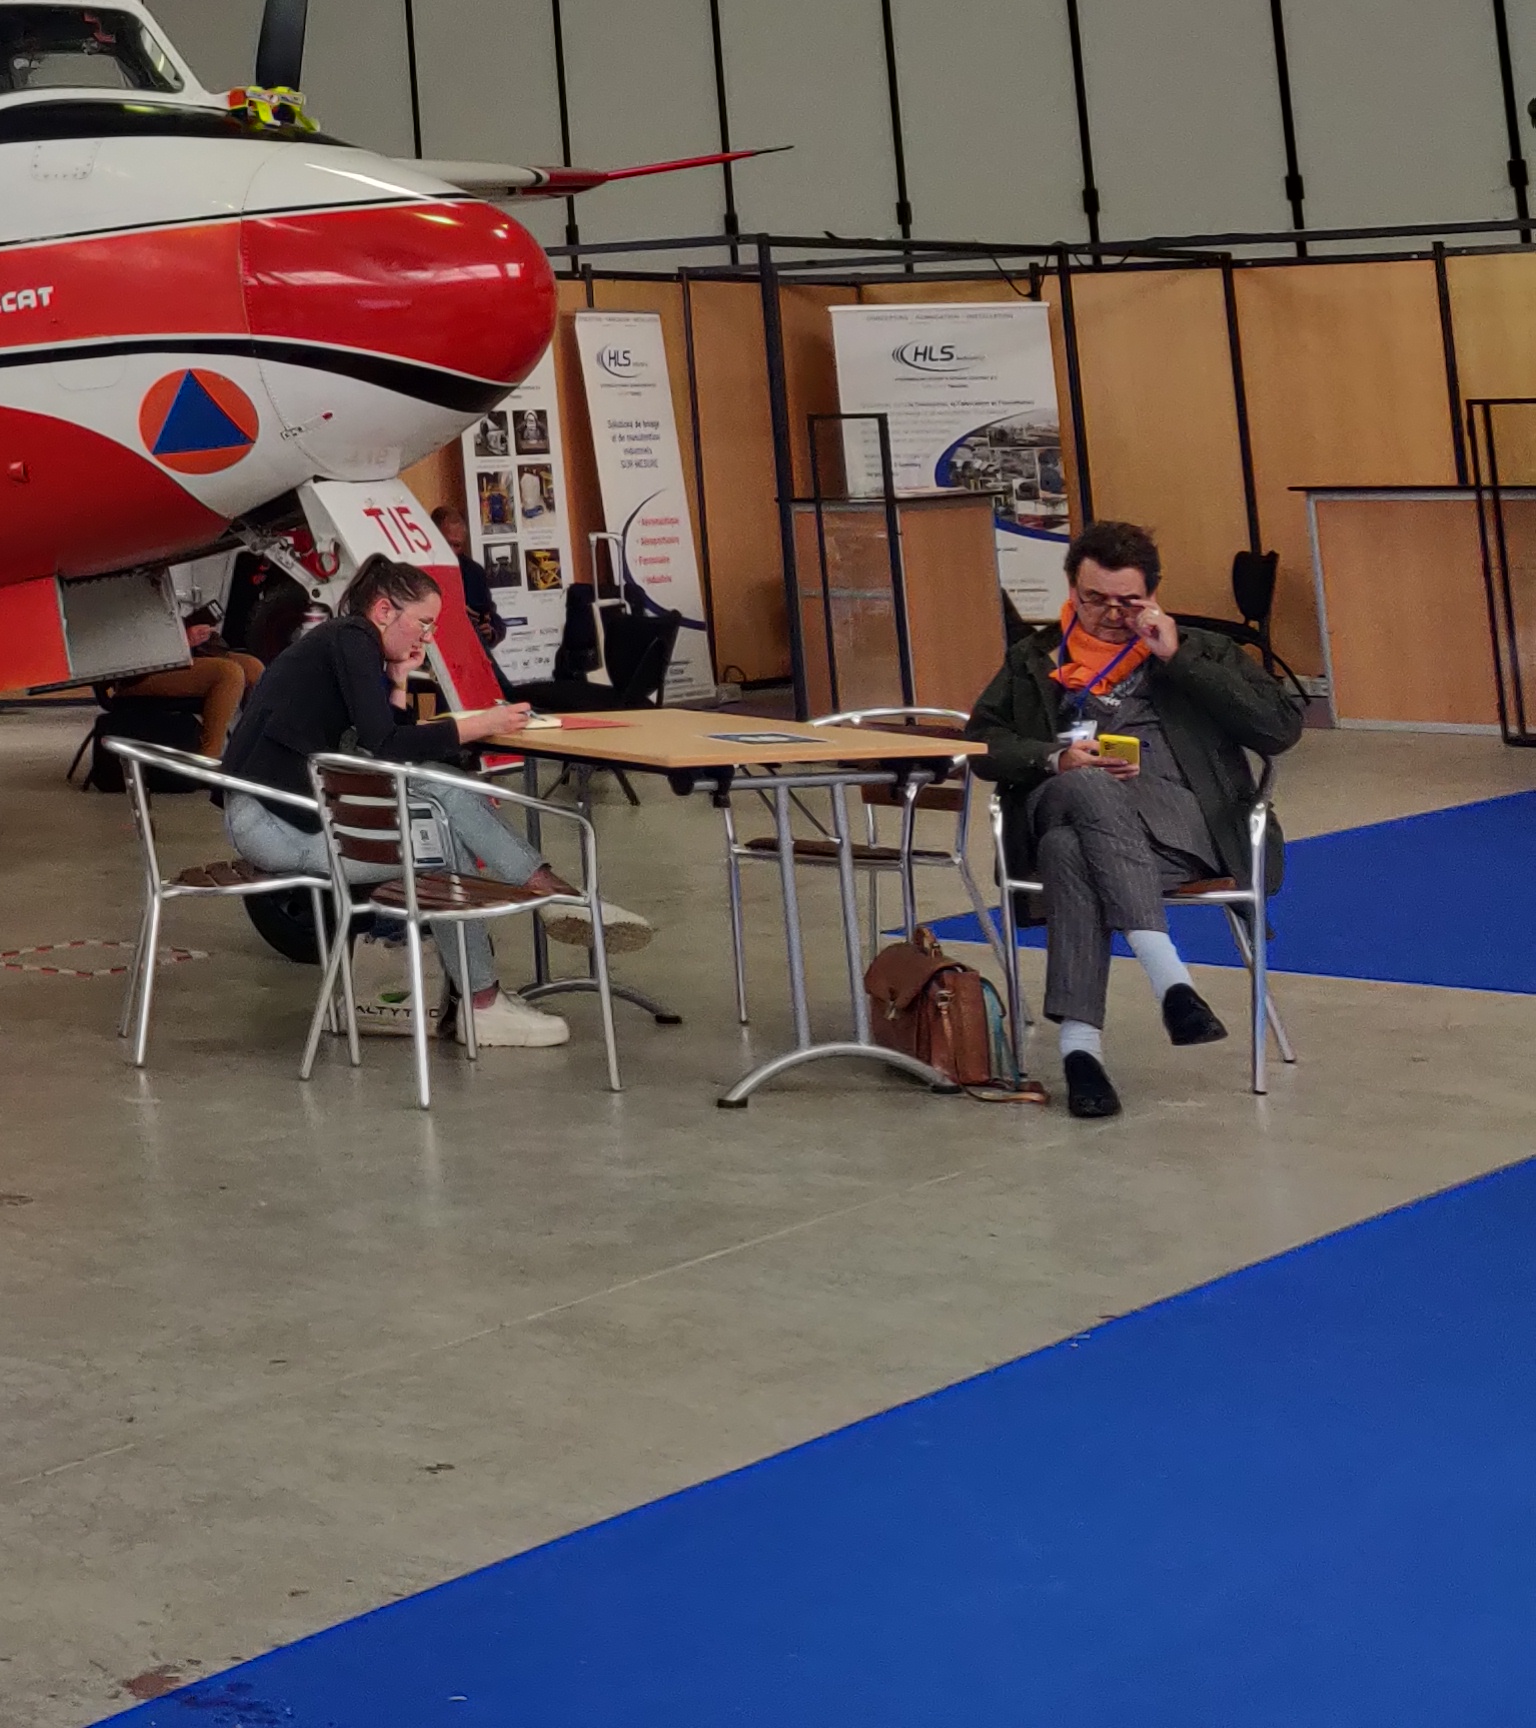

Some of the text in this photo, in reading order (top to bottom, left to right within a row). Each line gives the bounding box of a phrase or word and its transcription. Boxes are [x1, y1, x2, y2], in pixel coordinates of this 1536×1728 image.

[608, 349, 631, 367] HLS
[913, 345, 955, 362] HLS
[362, 505, 433, 555] T15
